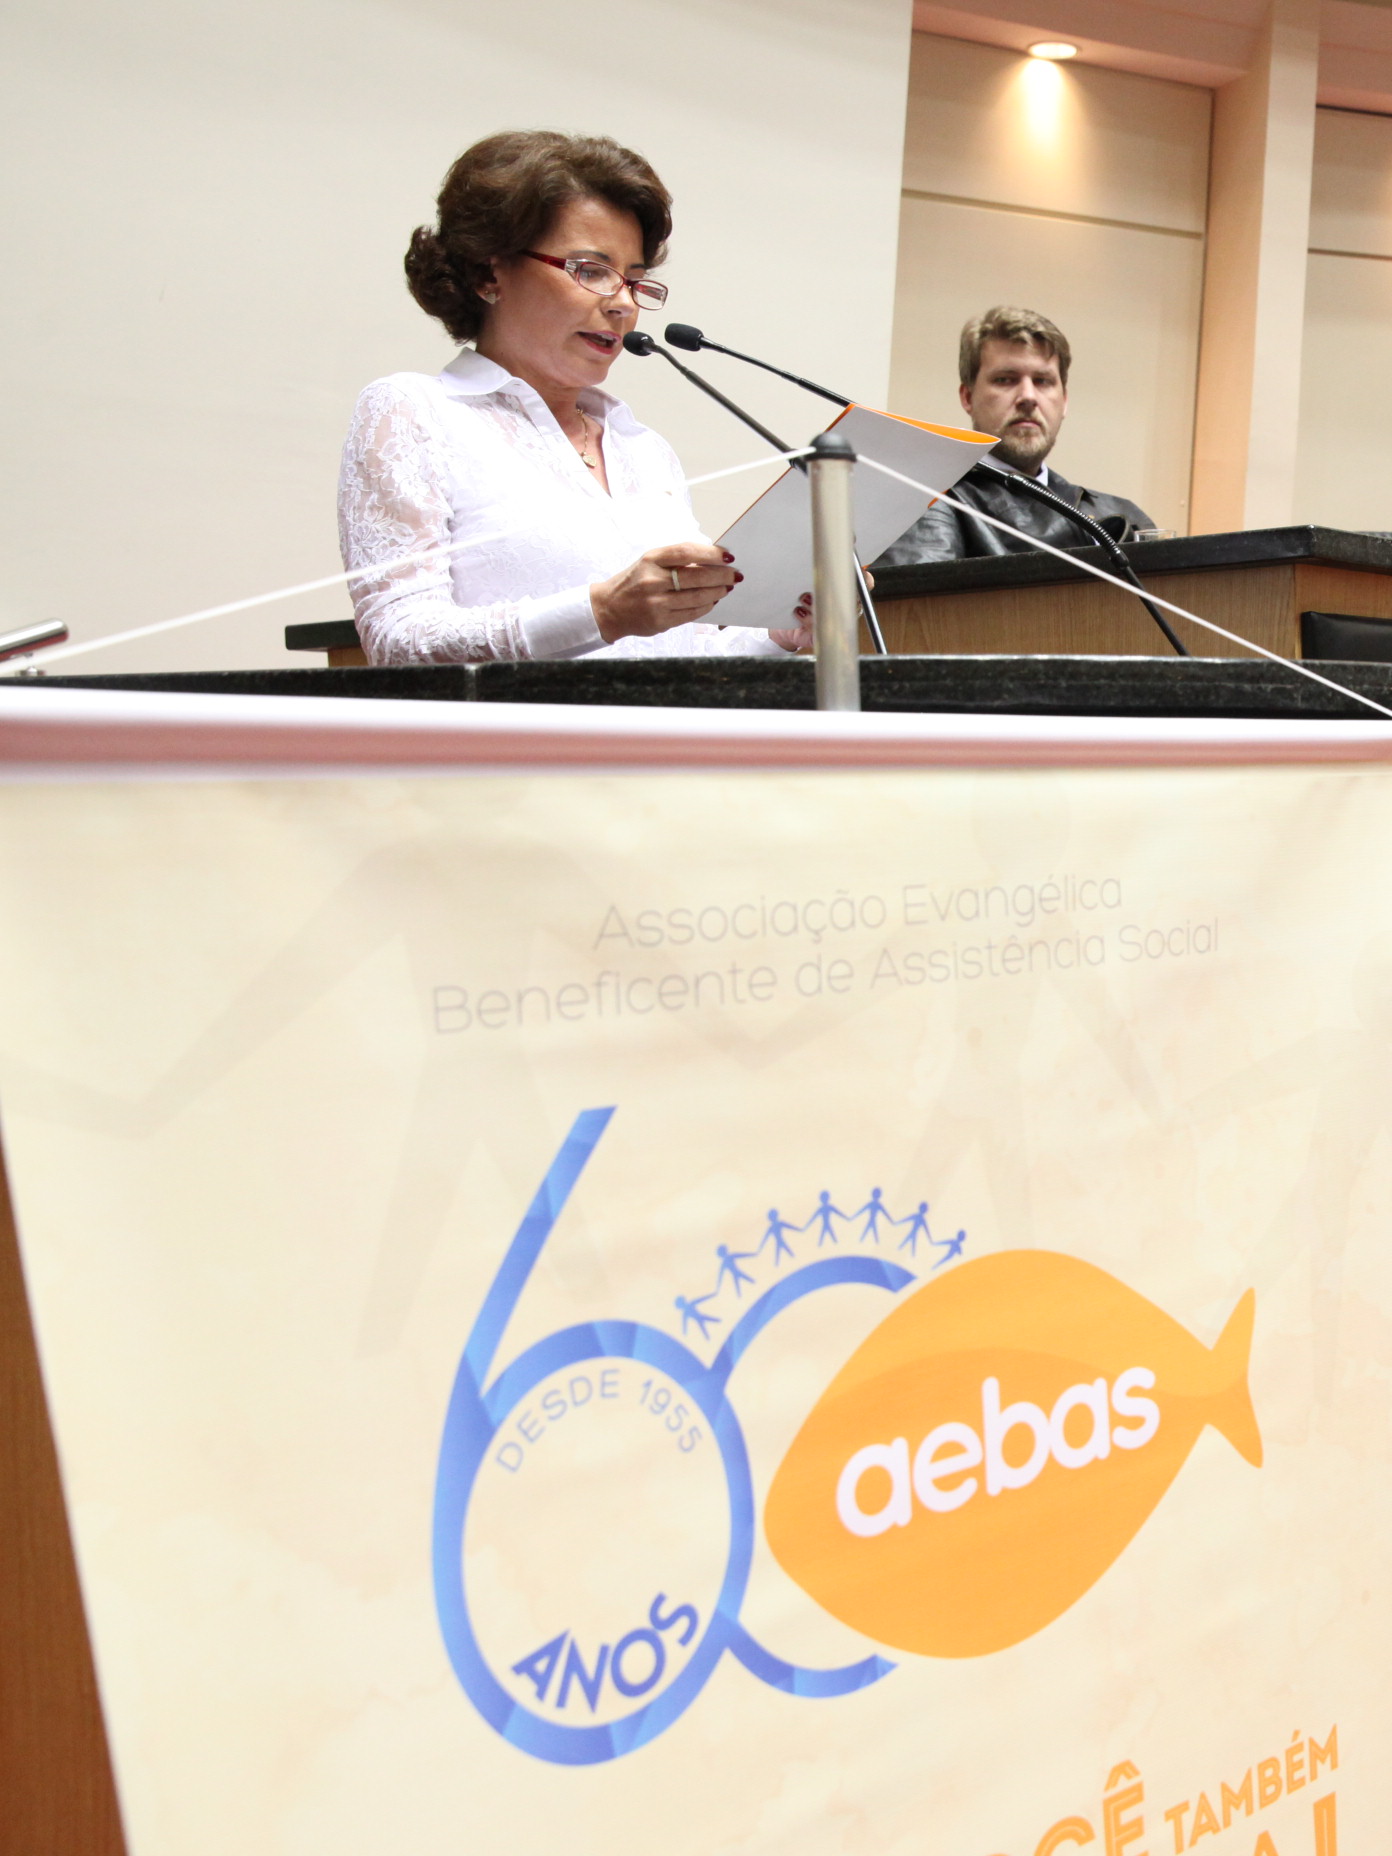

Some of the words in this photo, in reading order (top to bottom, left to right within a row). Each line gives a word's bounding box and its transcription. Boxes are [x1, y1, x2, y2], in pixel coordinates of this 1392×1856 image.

[591, 886, 887, 952] Associação
[901, 871, 1124, 929] Evangélica
[431, 959, 778, 1036] Beneficente
[794, 952, 855, 999] de
[867, 926, 1107, 991] Assistência
[1117, 917, 1220, 962] Social
[494, 1368, 621, 1474] DESDE
[639, 1378, 703, 1454] 1955
[835, 1365, 1161, 1538] aebas
[510, 1591, 701, 1714] ANOS
[1164, 1723, 1339, 1856] TAMBÉM
